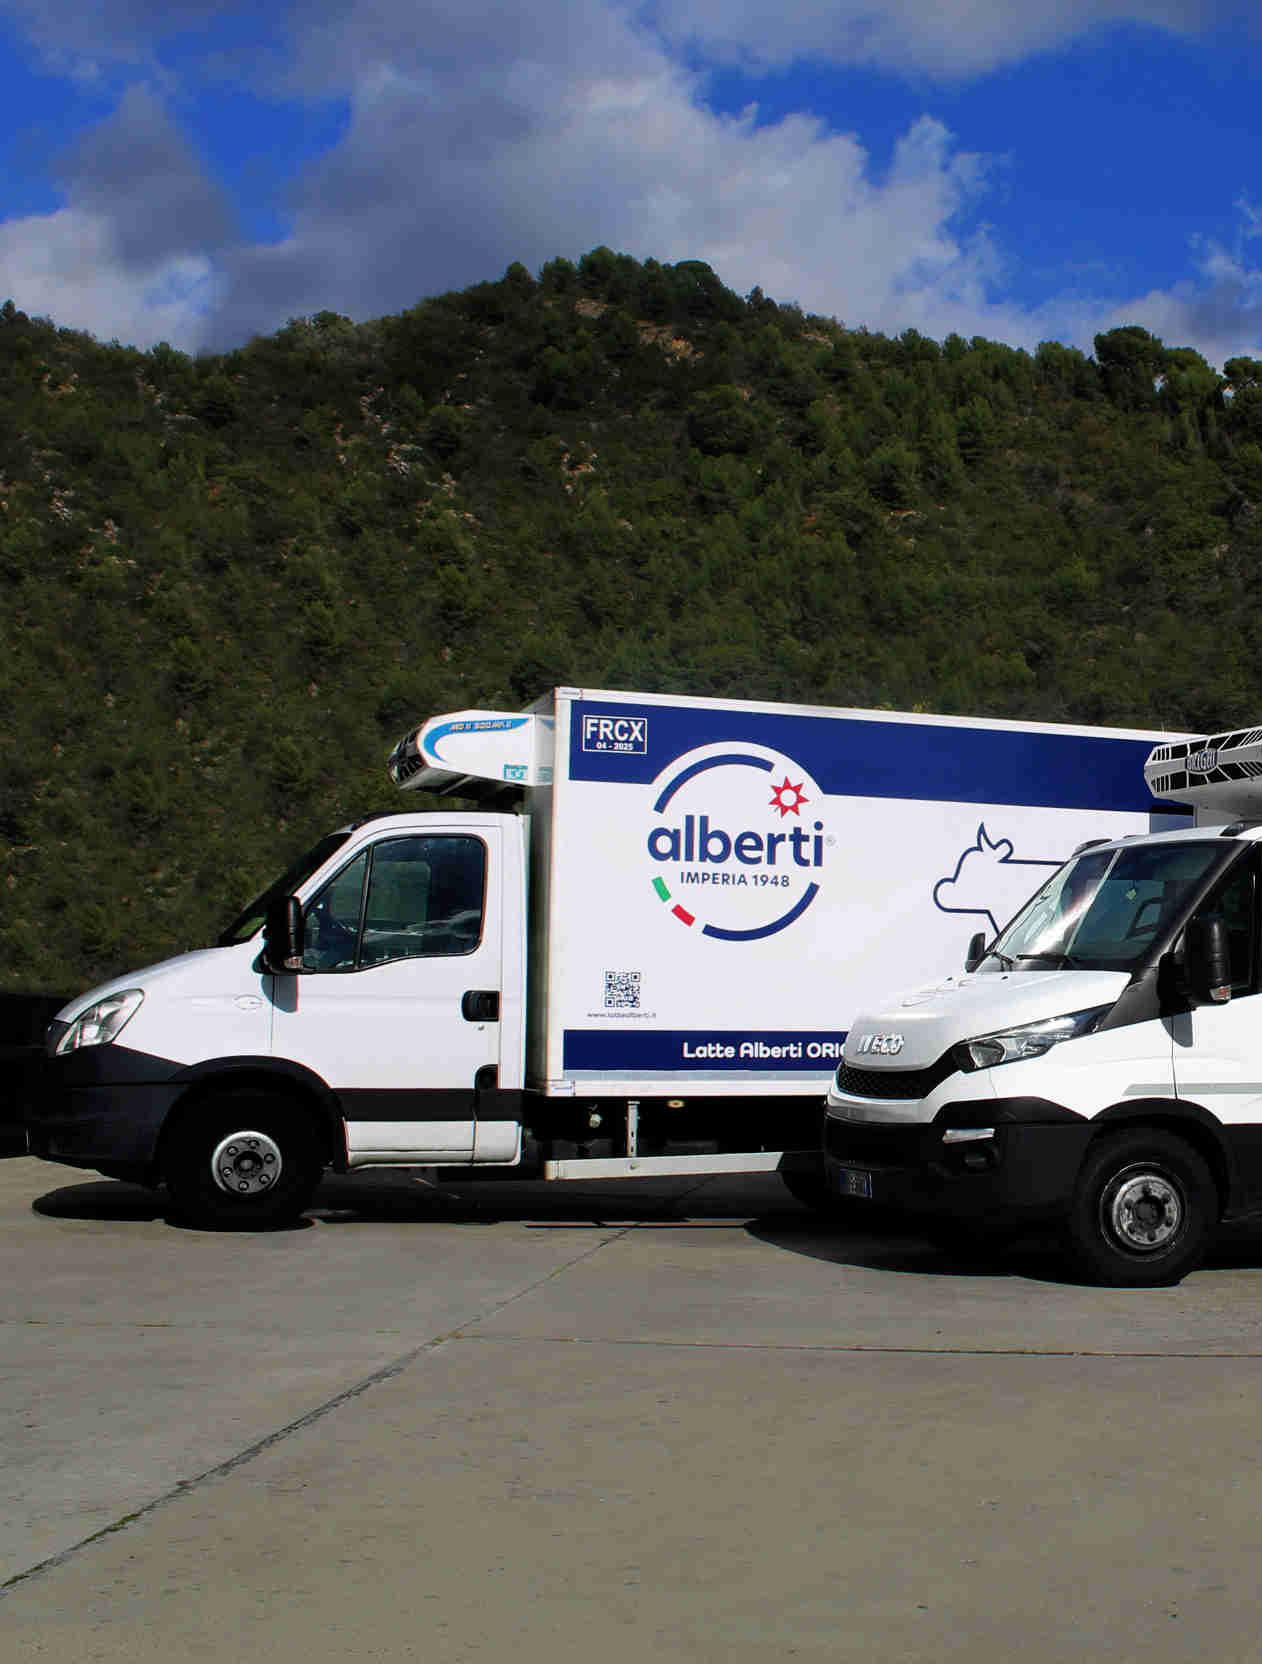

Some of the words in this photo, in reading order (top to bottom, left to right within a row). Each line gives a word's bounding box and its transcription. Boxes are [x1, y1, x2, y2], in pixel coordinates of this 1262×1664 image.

[586, 718, 644, 742] FRCX
[596, 741, 607, 749] 04
[613, 742, 634, 751] 2025
[647, 815, 824, 867] alberti
[680, 871, 748, 886] IMPERIA
[752, 874, 791, 888] 1948
[682, 1042, 736, 1059] Latte
[739, 1042, 802, 1059] Alberti
[856, 1034, 905, 1056] IVECO
